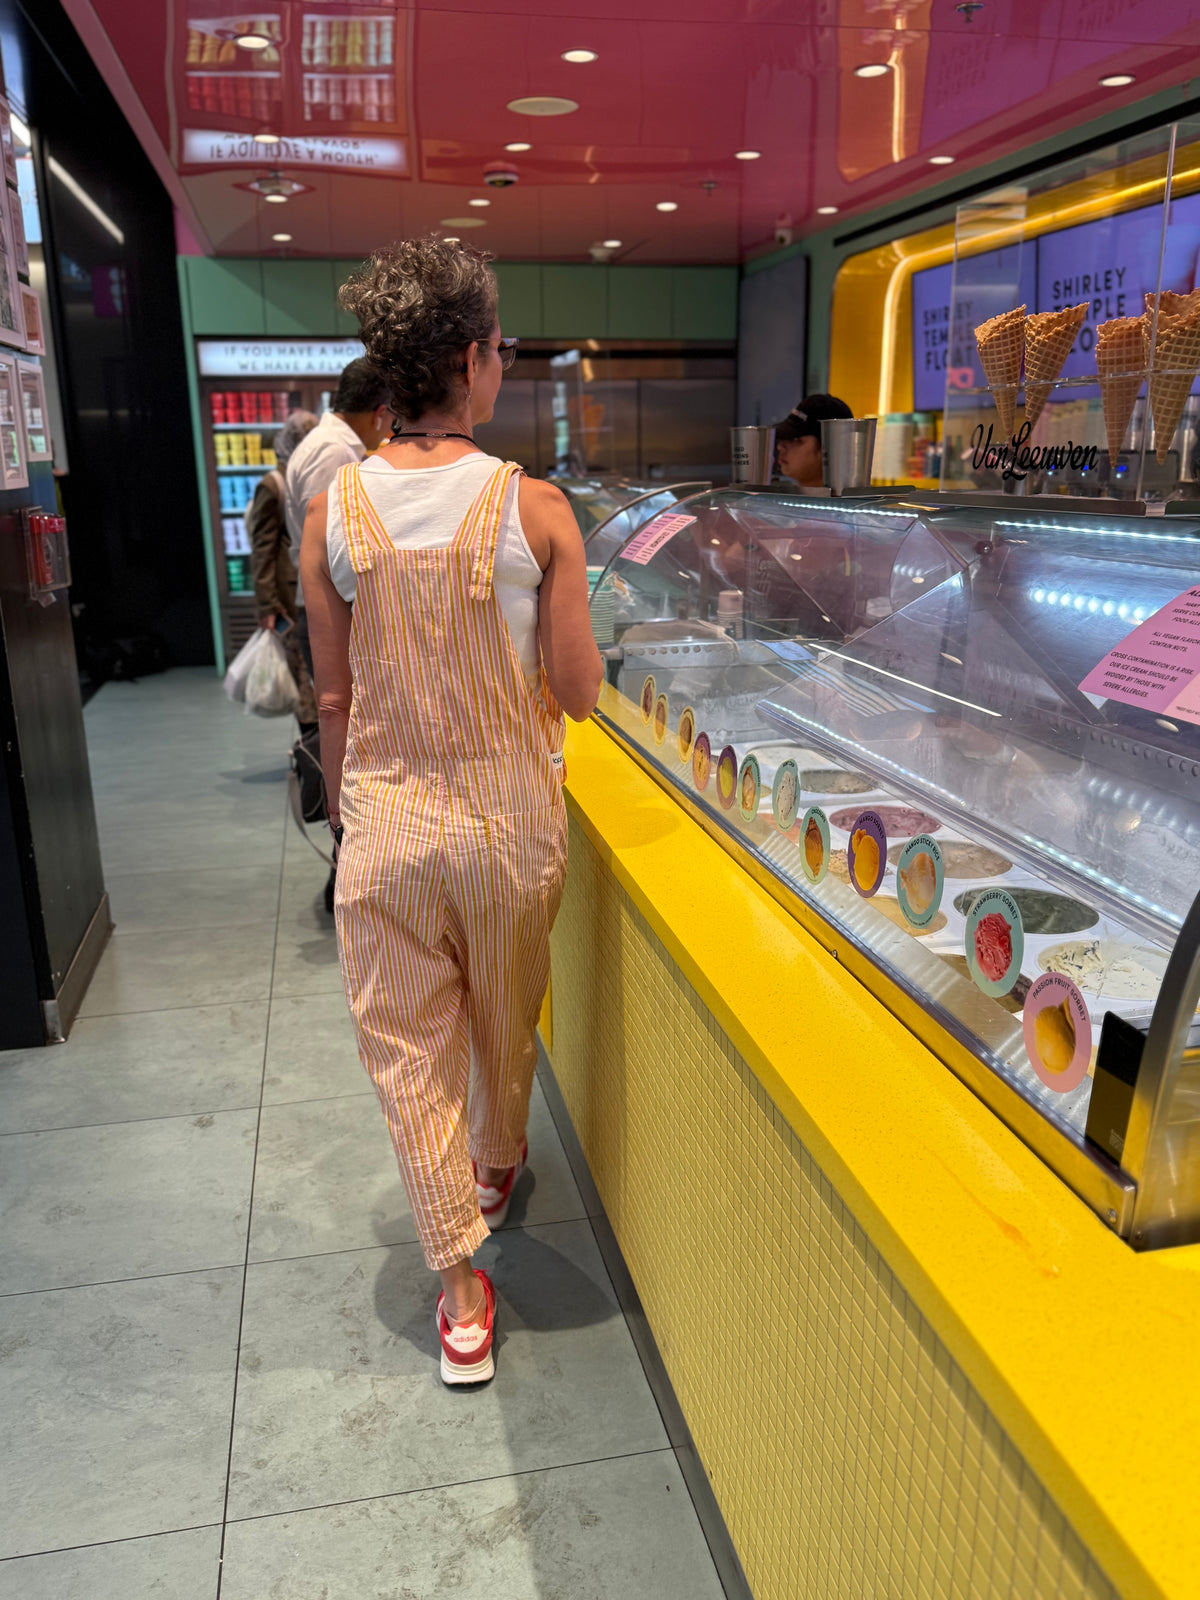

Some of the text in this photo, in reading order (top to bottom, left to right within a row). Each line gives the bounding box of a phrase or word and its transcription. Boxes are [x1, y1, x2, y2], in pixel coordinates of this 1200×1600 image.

[1053, 266, 1127, 300] SHIRLEY
[923, 301, 974, 327] SHIREY
[1053, 293, 1126, 321] PLE
[924, 322, 974, 347] TEMLE
[242, 346, 273, 357] YOU
[276, 346, 312, 357] HAVE
[318, 346, 328, 357] A
[264, 361, 299, 371] HAVE
[305, 361, 315, 371] A
[971, 421, 1099, 481] Van Leeuwen
[1149, 640, 1173, 649] CONTAIN
[1162, 633, 1181, 641] VEGAN
[1110, 651, 1128, 660] CROSS
[1127, 655, 1171, 669] CONTAMINATION
[1104, 670, 1127, 680] AVOIDED
[1134, 677, 1152, 687] THOSE
[1129, 666, 1149, 675] CREAM
[1147, 670, 1170, 680] SHOULD
[1102, 681, 1122, 690] SEVERE
[859, 815, 873, 825] MANGO
[905, 837, 940, 861] MANGO STICKY RICE
[973, 892, 1018, 920] STRAWBERRY SORBET
[1032, 977, 1087, 1022] PASSION FRUIT SORBET
[453, 1335, 478, 1343] adidas
